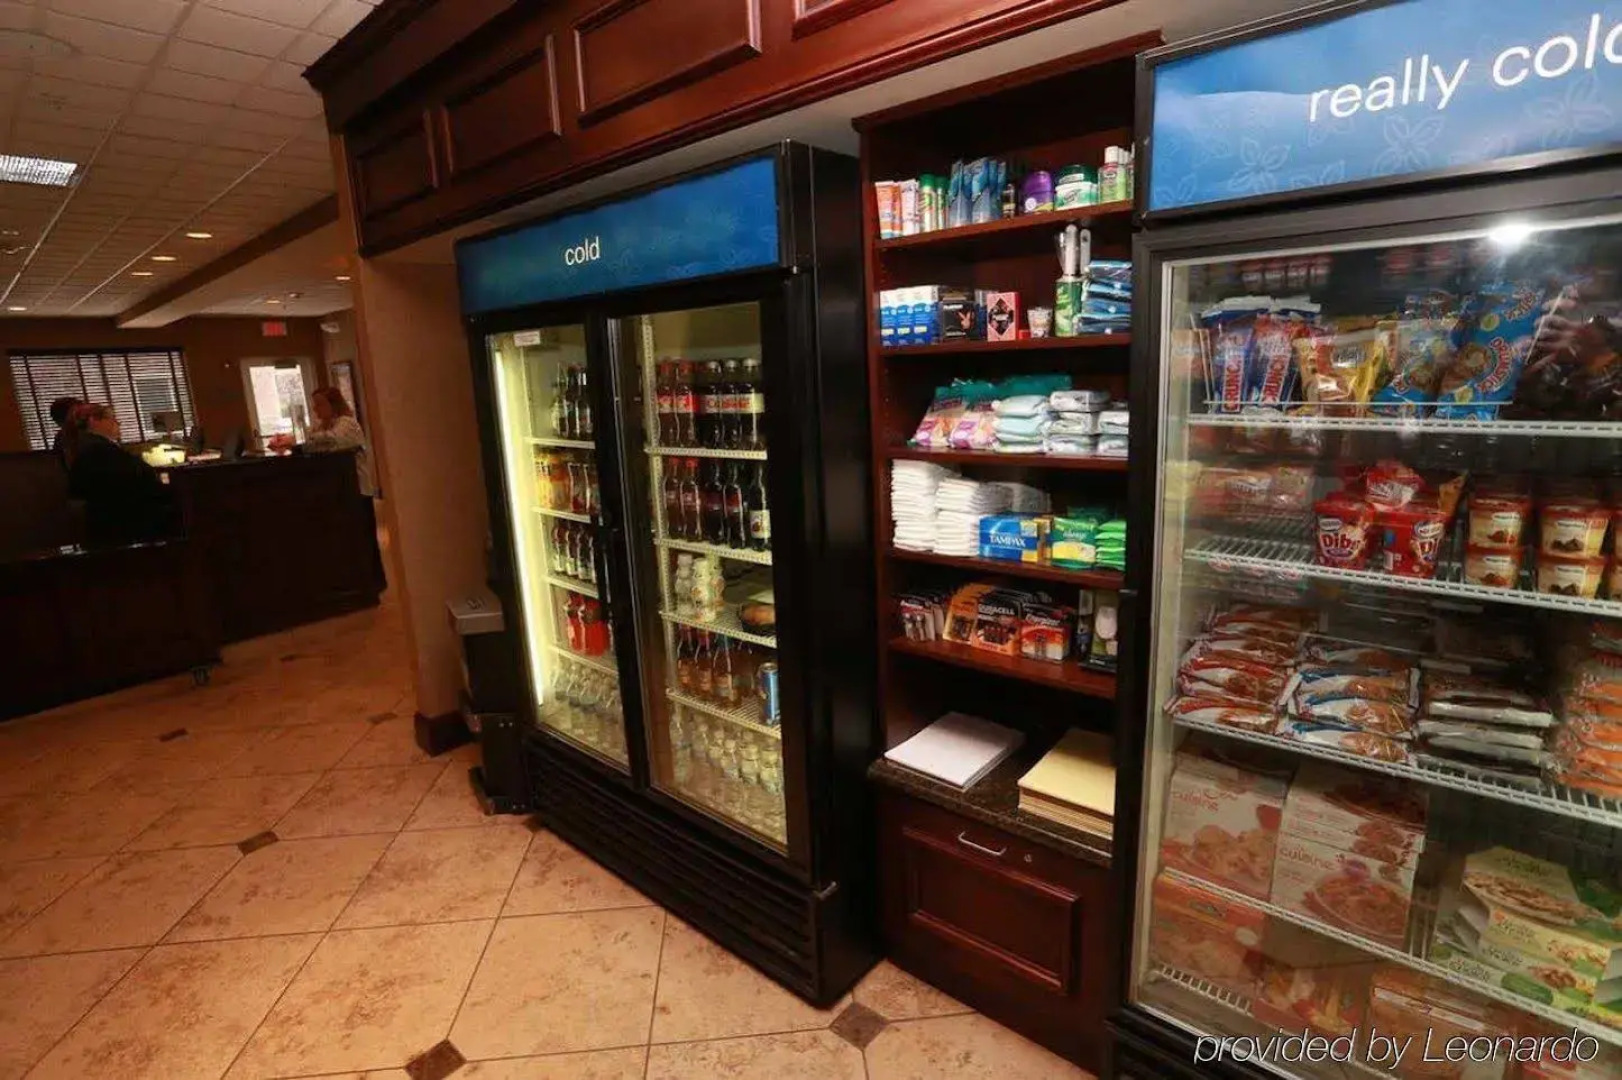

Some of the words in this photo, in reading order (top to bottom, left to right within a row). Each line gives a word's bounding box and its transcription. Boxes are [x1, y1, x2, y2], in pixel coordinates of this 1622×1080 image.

[1308, 54, 1470, 123] really
[564, 235, 601, 266] cold
[990, 535, 1026, 547] TAMPAX
[978, 604, 1015, 615] DURACELL
